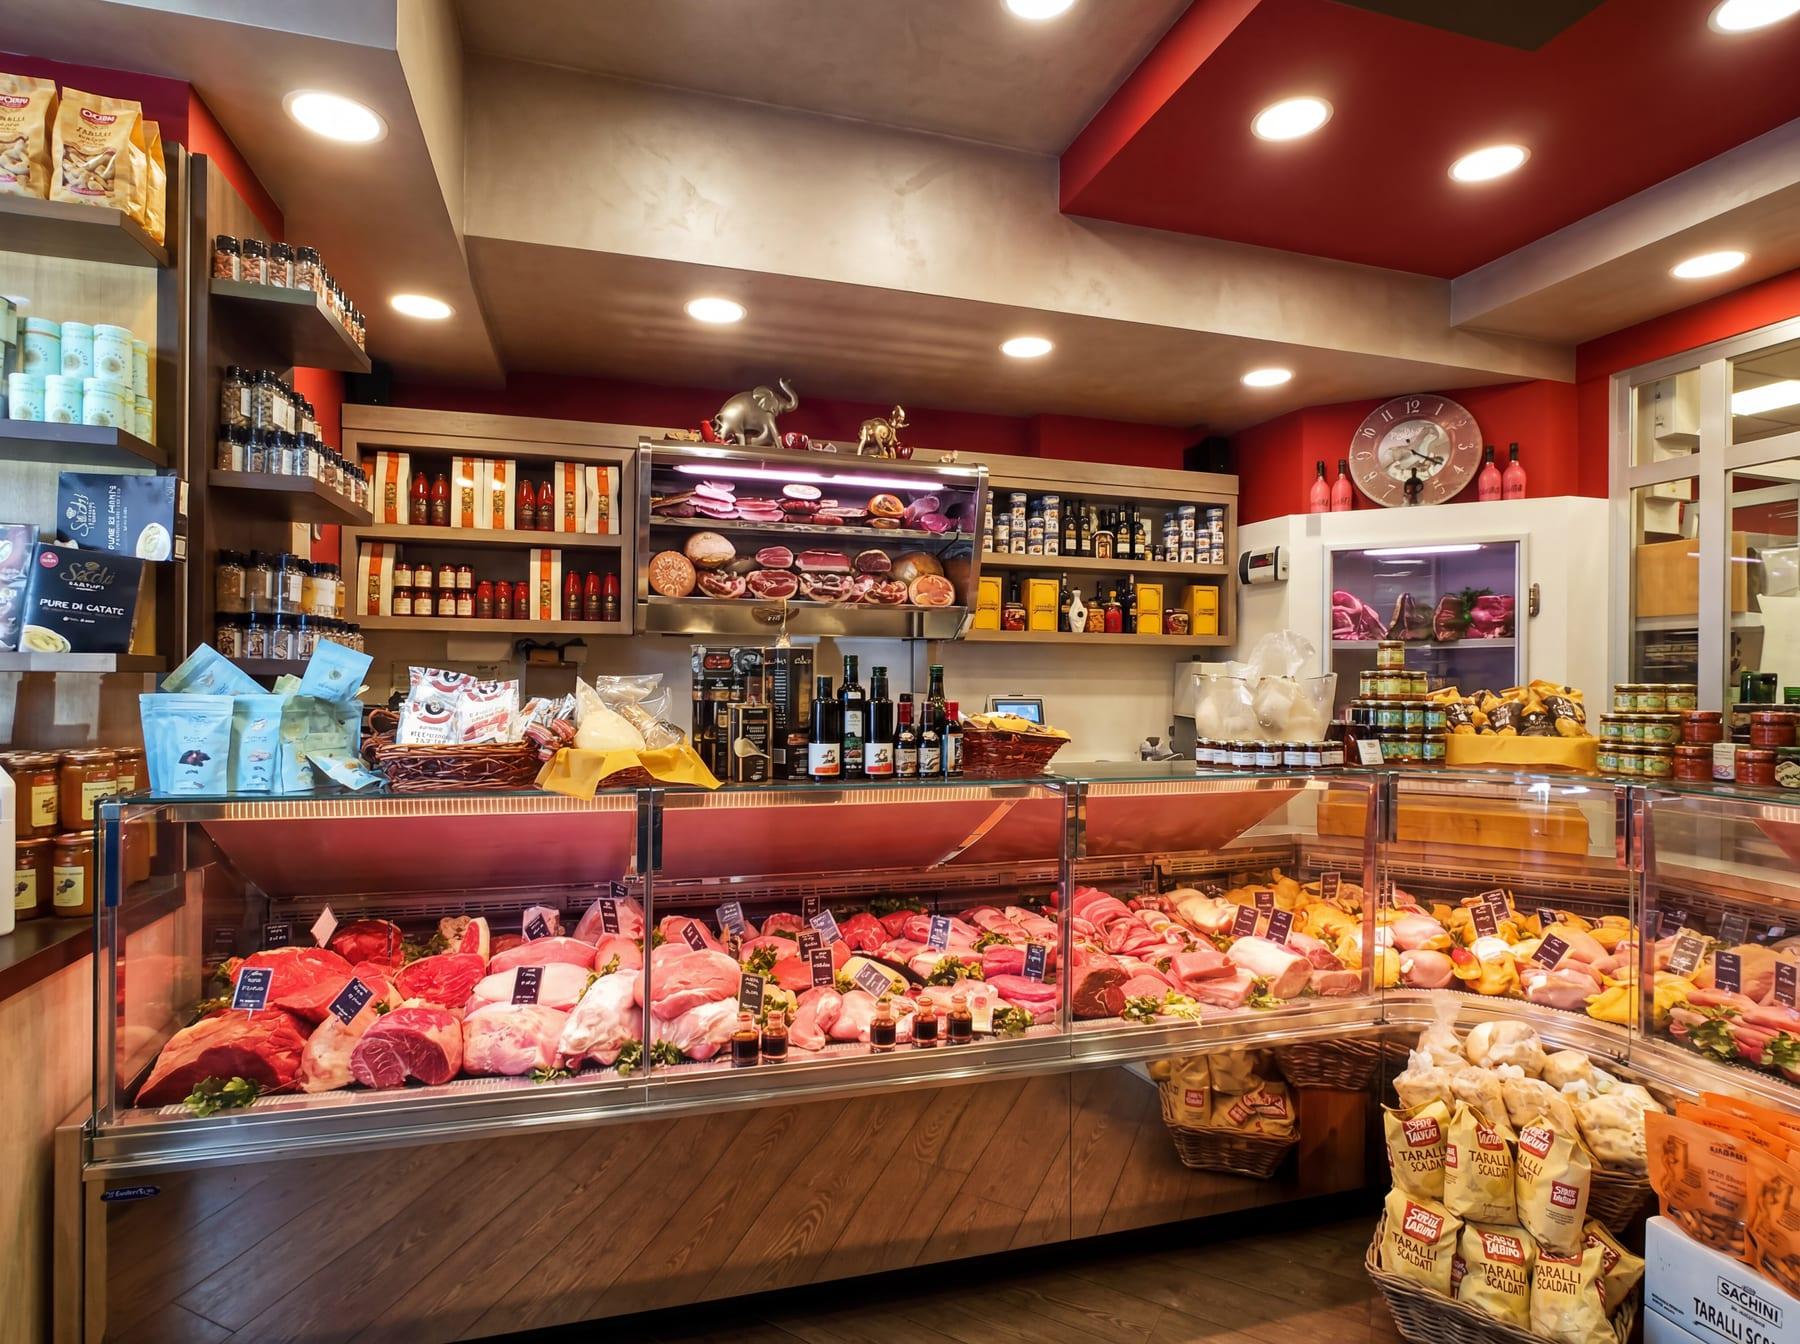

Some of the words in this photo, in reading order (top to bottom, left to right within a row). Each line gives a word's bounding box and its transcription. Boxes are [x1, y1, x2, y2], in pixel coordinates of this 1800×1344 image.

[1405, 399, 1420, 414] 12
[1435, 402, 1444, 416] 1
[1381, 409, 1394, 422] 11
[1361, 427, 1377, 439] 10
[1457, 442, 1474, 451] 3
[1356, 451, 1373, 461] 9
[1363, 471, 1378, 483] 8
[1453, 464, 1465, 475] 4
[1382, 484, 1397, 499] 7
[39, 598, 70, 609] PURE
[71, 602, 83, 611] DI
[1398, 1146, 1447, 1162] TARALL
[1411, 1158, 1447, 1172] SCALDAT
[1391, 1231, 1438, 1261] TARALLI
[1396, 1246, 1433, 1273] SCALDATI
[1479, 1262, 1528, 1285] TARALLI
[1535, 1264, 1581, 1285] TARALLI
[1485, 1275, 1525, 1297] SCALDATI
[1537, 1277, 1576, 1296] SCALDATI
[1720, 1282, 1778, 1323] SACHINI
[1692, 1296, 1742, 1341] TARALLI
